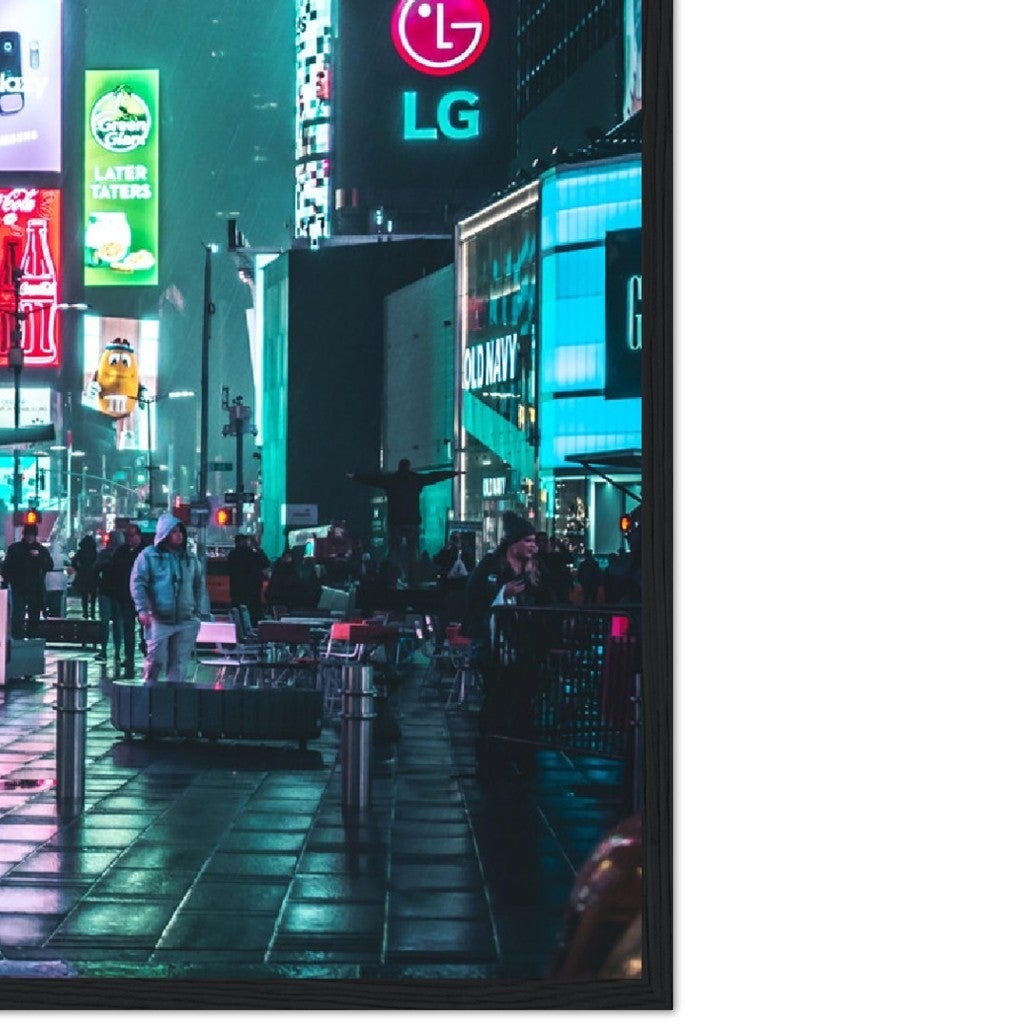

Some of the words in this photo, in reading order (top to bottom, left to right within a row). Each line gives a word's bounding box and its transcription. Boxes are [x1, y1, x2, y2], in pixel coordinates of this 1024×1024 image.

[403, 90, 480, 140] LG
[93, 164, 148, 182] LATER
[91, 183, 152, 200] TATERS
[463, 344, 484, 390] OLD
[485, 333, 518, 386] NAVY
